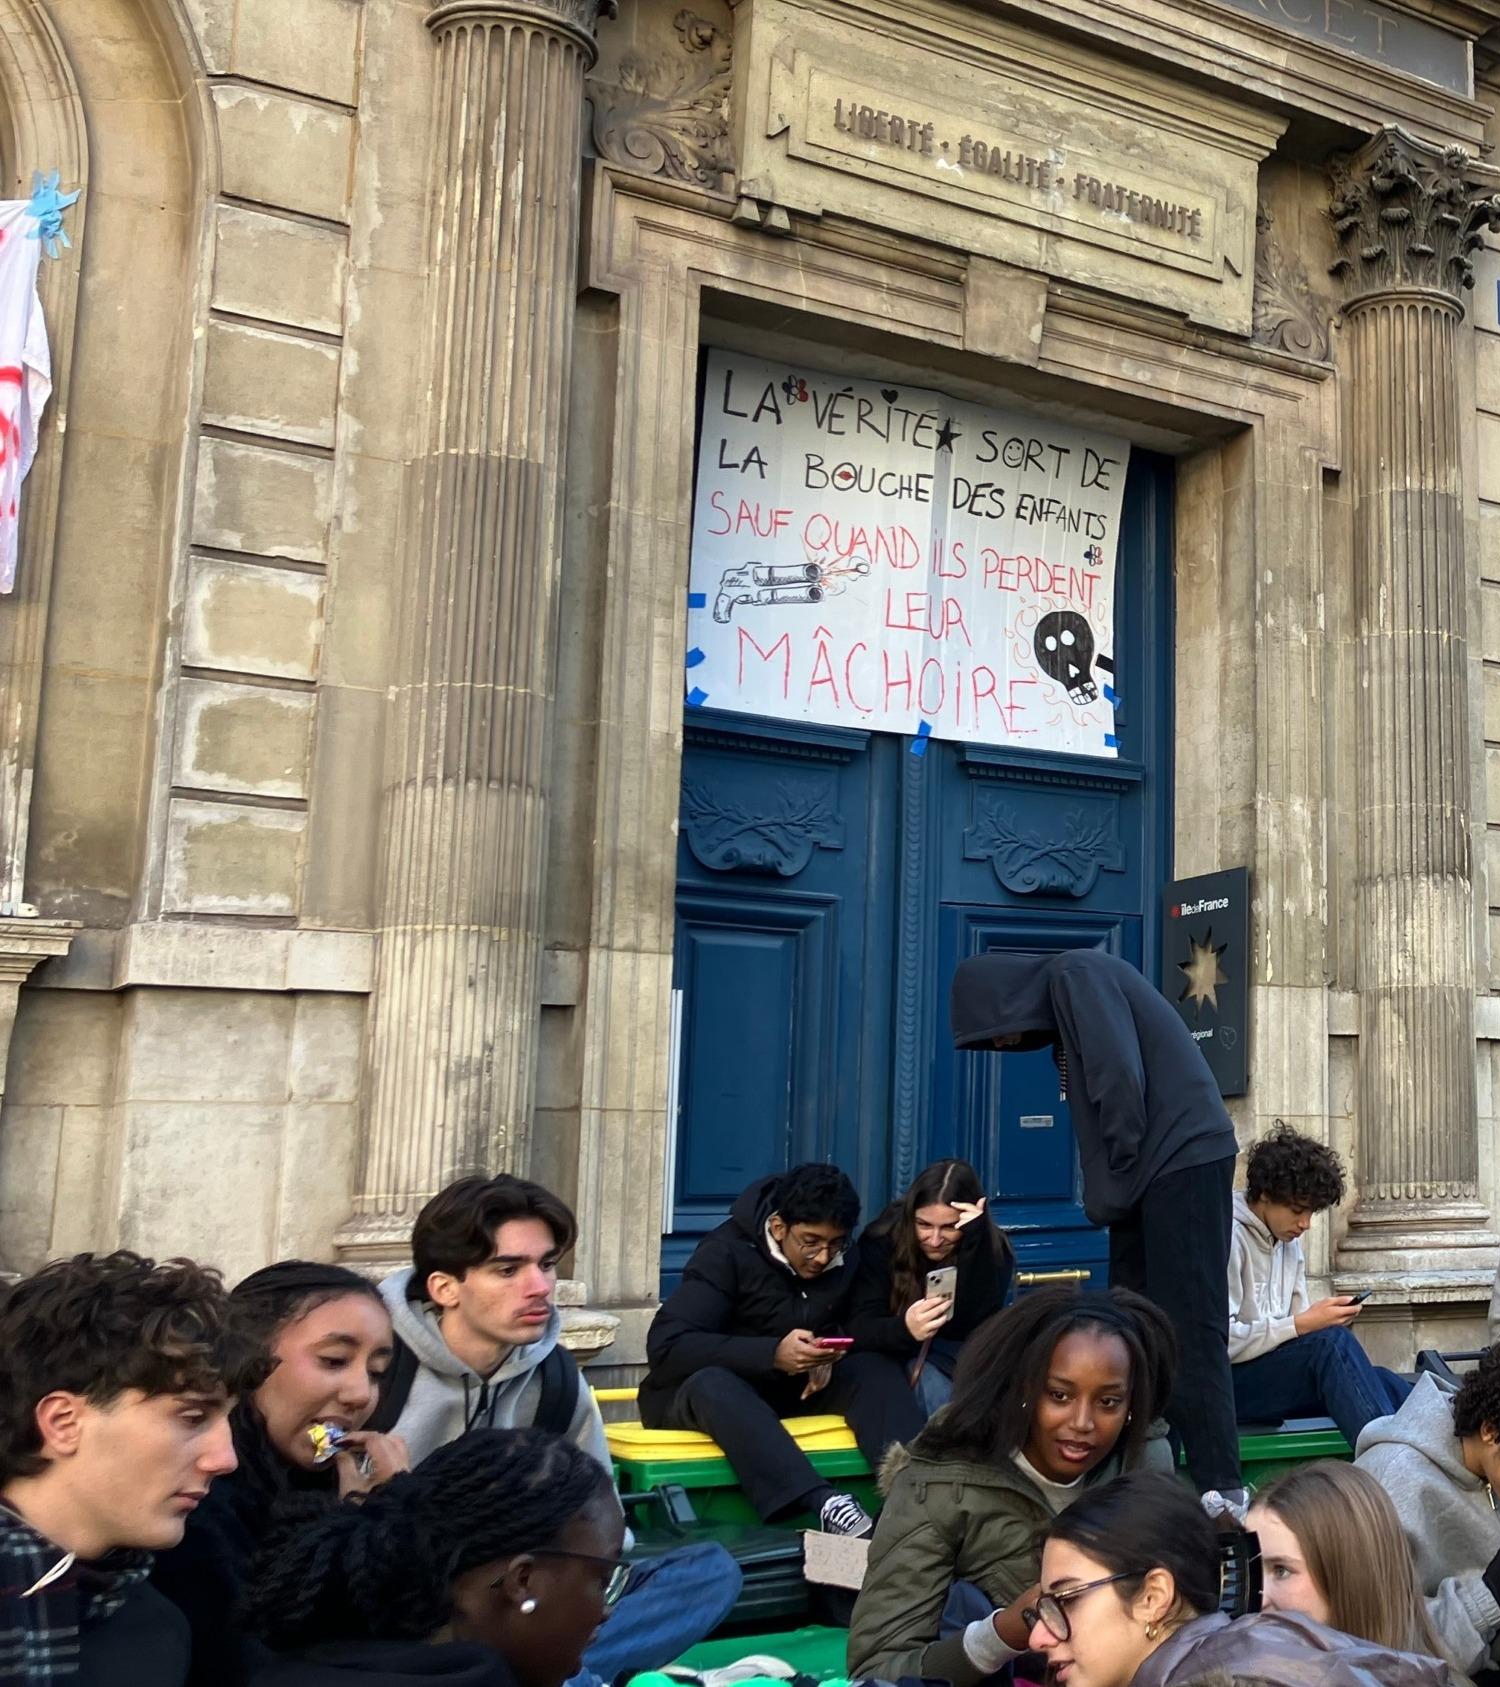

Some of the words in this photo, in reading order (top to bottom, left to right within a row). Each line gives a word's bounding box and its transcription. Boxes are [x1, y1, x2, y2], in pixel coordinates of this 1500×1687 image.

[1258, 0, 1399, 53] CET
[834, 98, 934, 154] LIBERTÉ
[957, 134, 1051, 191] ÉGALITÉ
[1072, 173, 1203, 238] FRATERNITÉ
[723, 369, 782, 424] LA
[976, 431, 1070, 479] SORT
[1081, 448, 1120, 490] DE
[719, 438, 768, 479] LA
[805, 453, 934, 502] BOUCHE
[953, 477, 1005, 519] DES
[1016, 494, 1107, 540] ENFANTS
[708, 491, 794, 538] SAUF
[804, 513, 921, 569] QUAND
[981, 548, 1101, 609] PERDENT
[885, 588, 971, 647] LEUR
